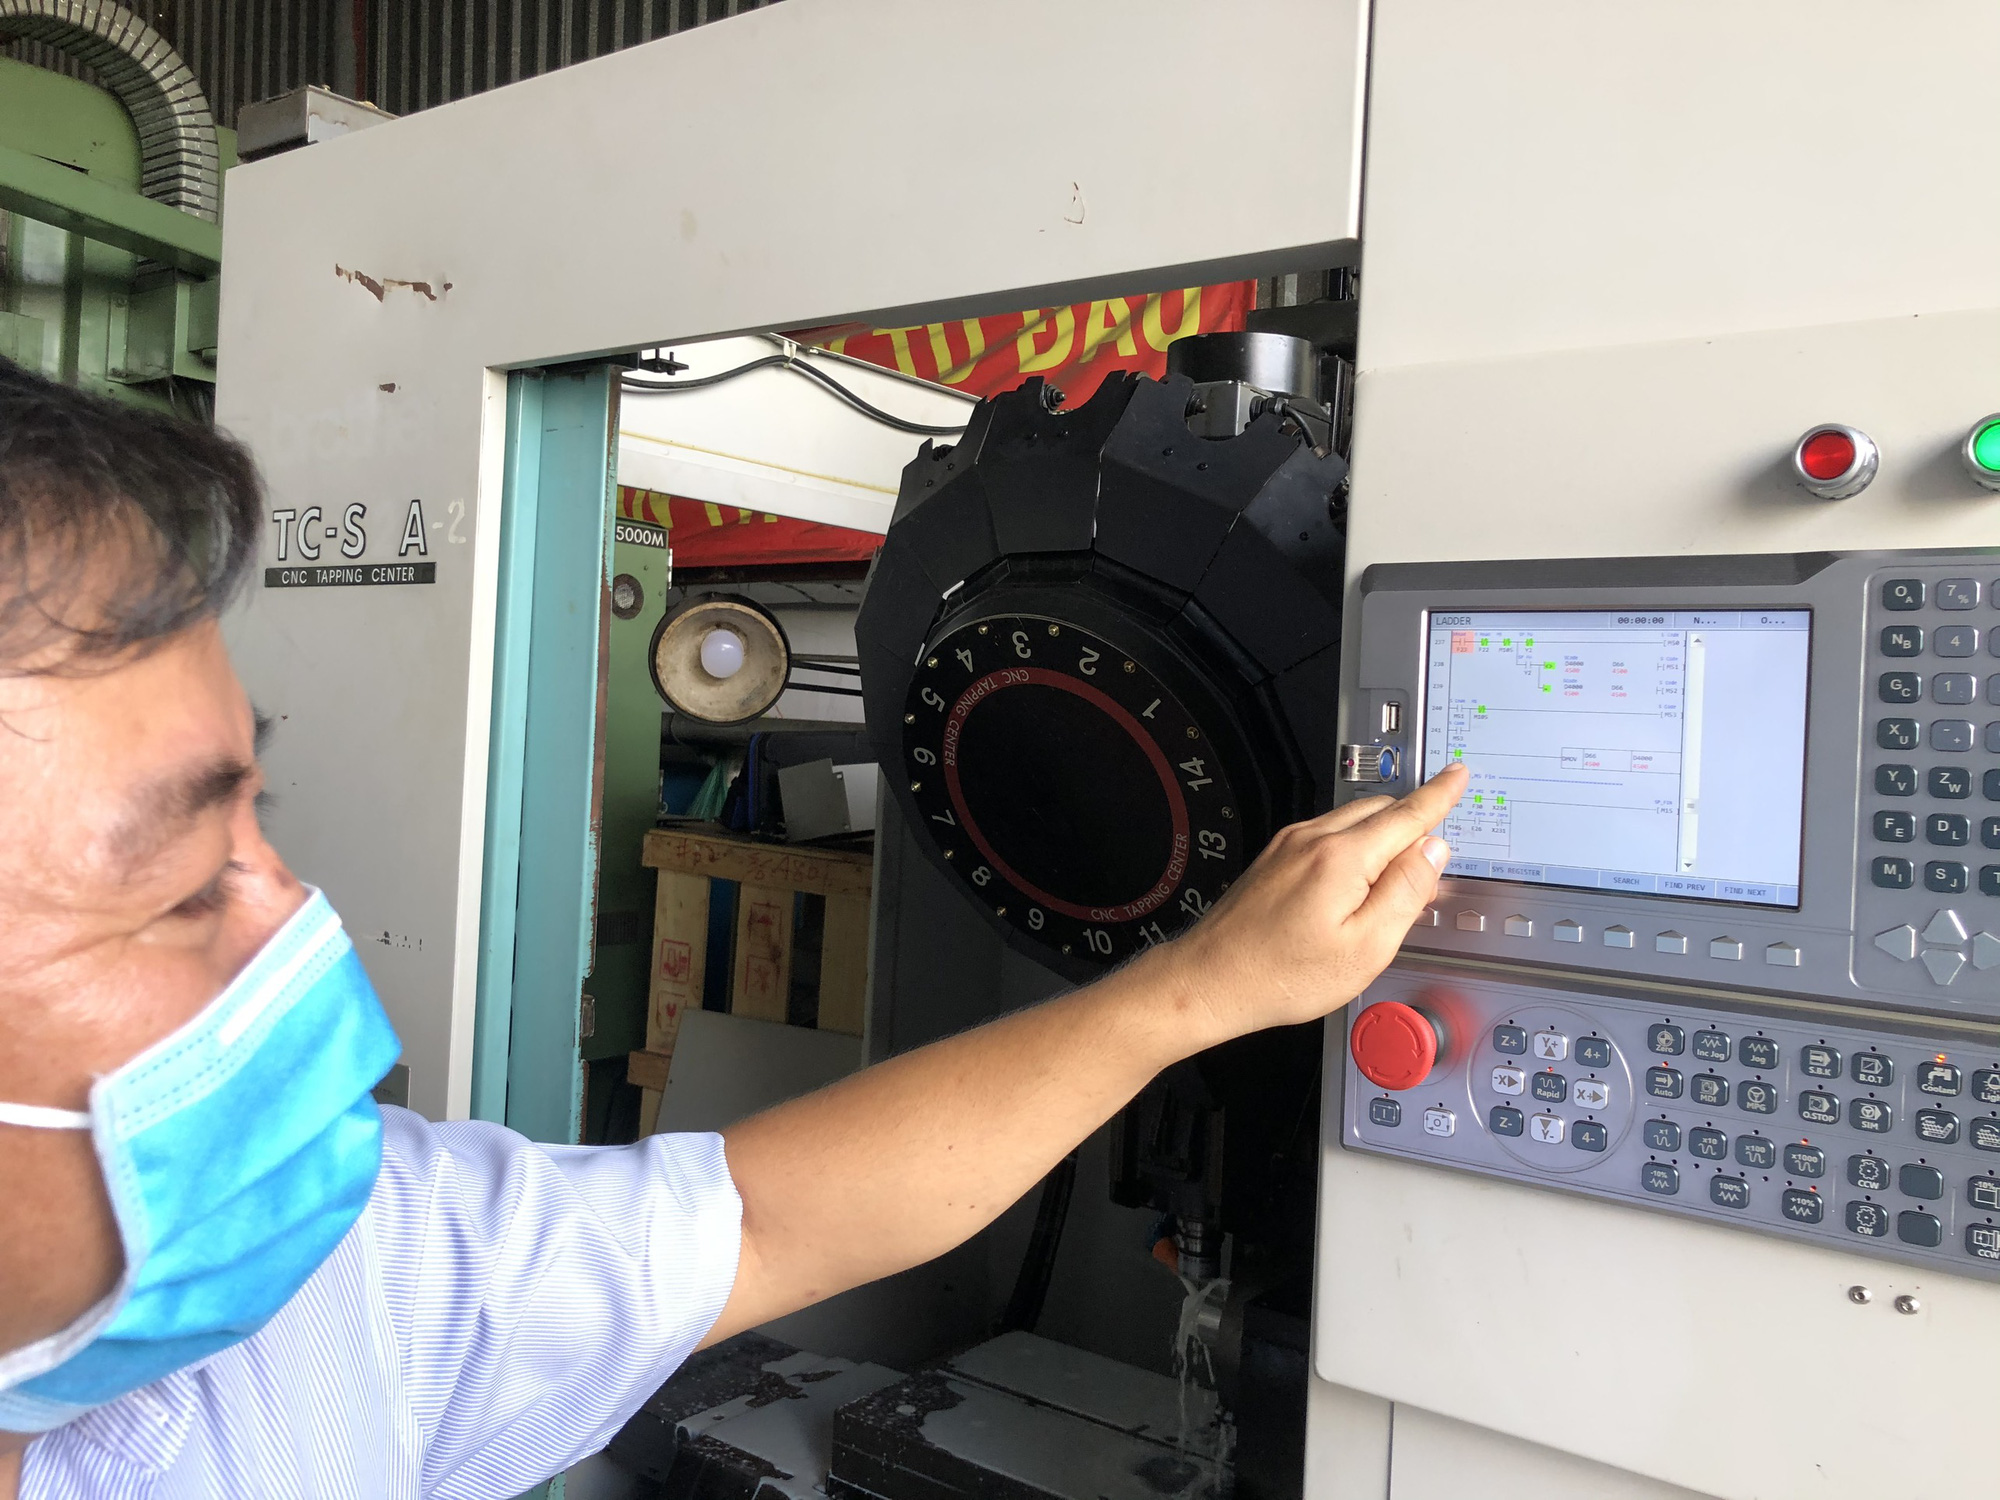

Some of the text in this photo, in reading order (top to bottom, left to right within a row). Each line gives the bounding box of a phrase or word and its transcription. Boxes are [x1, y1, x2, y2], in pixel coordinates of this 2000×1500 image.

[273, 499, 427, 561] TC-S A
[615, 526, 664, 546] 5000M
[281, 567, 415, 584] CNC TAPPING CENTER
[1436, 616, 1471, 625] LADDER
[1617, 616, 1664, 624] 00:00:00
[1011, 630, 1032, 659] 3
[1950, 636, 1961, 647] 4
[955, 647, 974, 673] 4
[1078, 646, 1100, 676] 2
[1944, 680, 1951, 692] 1
[921, 687, 945, 713] 5
[1142, 698, 1162, 719] 1
[944, 668, 1030, 767] CNC TAPPING CENTER
[1179, 757, 1212, 792] 14
[931, 808, 955, 827] 7
[1198, 829, 1227, 861] 13
[971, 865, 992, 887] 8
[1090, 833, 1188, 921] CNC TAPPING CENTER
[1508, 868, 1541, 876] REGISTER
[1613, 876, 1640, 885] SEARCH
[1664, 881, 1706, 892] FIND PREV
[1724, 886, 1767, 897] FIND NEXT
[1179, 888, 1212, 918] 12
[1083, 928, 1113, 955] 10
[1501, 1035, 1518, 1047] Z+
[1542, 1037, 1558, 1049] Y+
[1584, 1048, 1601, 1060] 4+
[1656, 1044, 1673, 1053] Zero
[1697, 1048, 1725, 1061] Inc Jog
[1750, 1055, 1766, 1065] Jog
[1859, 1073, 1883, 1084] B.O.T
[1536, 1088, 1560, 1100] Rapid
[1654, 1088, 1673, 1097] Auto
[1921, 1084, 1957, 1095] Coolant
[1700, 1094, 1717, 1103] MDI
[1746, 1102, 1766, 1111] MPG
[1499, 1117, 1513, 1128] Z-
[1861, 1121, 1879, 1130] SIM
[1542, 1129, 1555, 1141] Y-
[1582, 1132, 1595, 1143] 4-
[1650, 1170, 1668, 1178] -10%
[1719, 1183, 1742, 1192] 100%
[1858, 1180, 1880, 1189] CCW
[1790, 1197, 1815, 1207] +10%
[1857, 1226, 1873, 1235] CW
